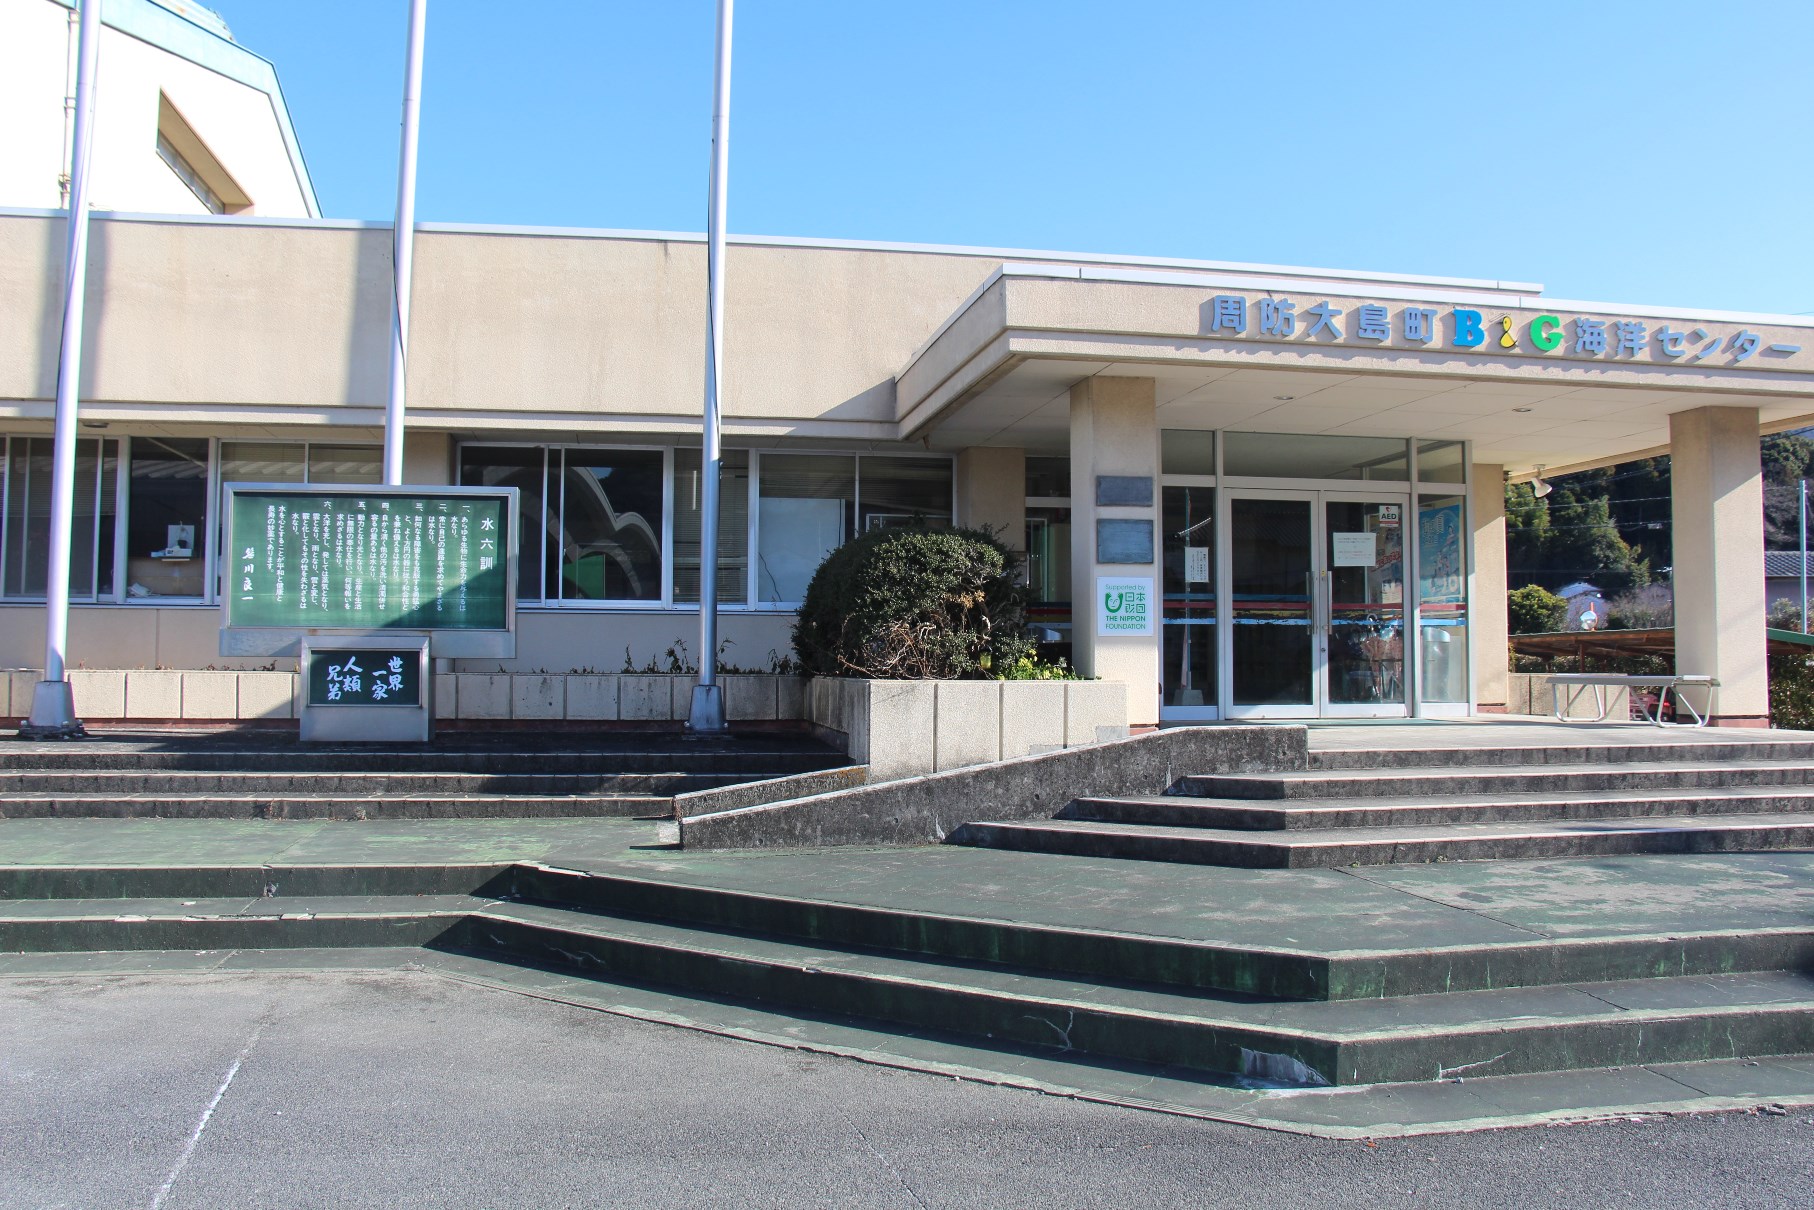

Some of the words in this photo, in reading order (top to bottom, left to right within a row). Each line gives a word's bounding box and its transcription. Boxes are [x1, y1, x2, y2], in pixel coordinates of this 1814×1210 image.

[480, 517, 494, 570] 水六訓
[1125, 592, 1146, 602] 日本
[326, 665, 343, 701] 兄弟
[342, 655, 364, 693] 人類
[371, 669, 388, 700] 一家
[387, 655, 404, 691] 世界
